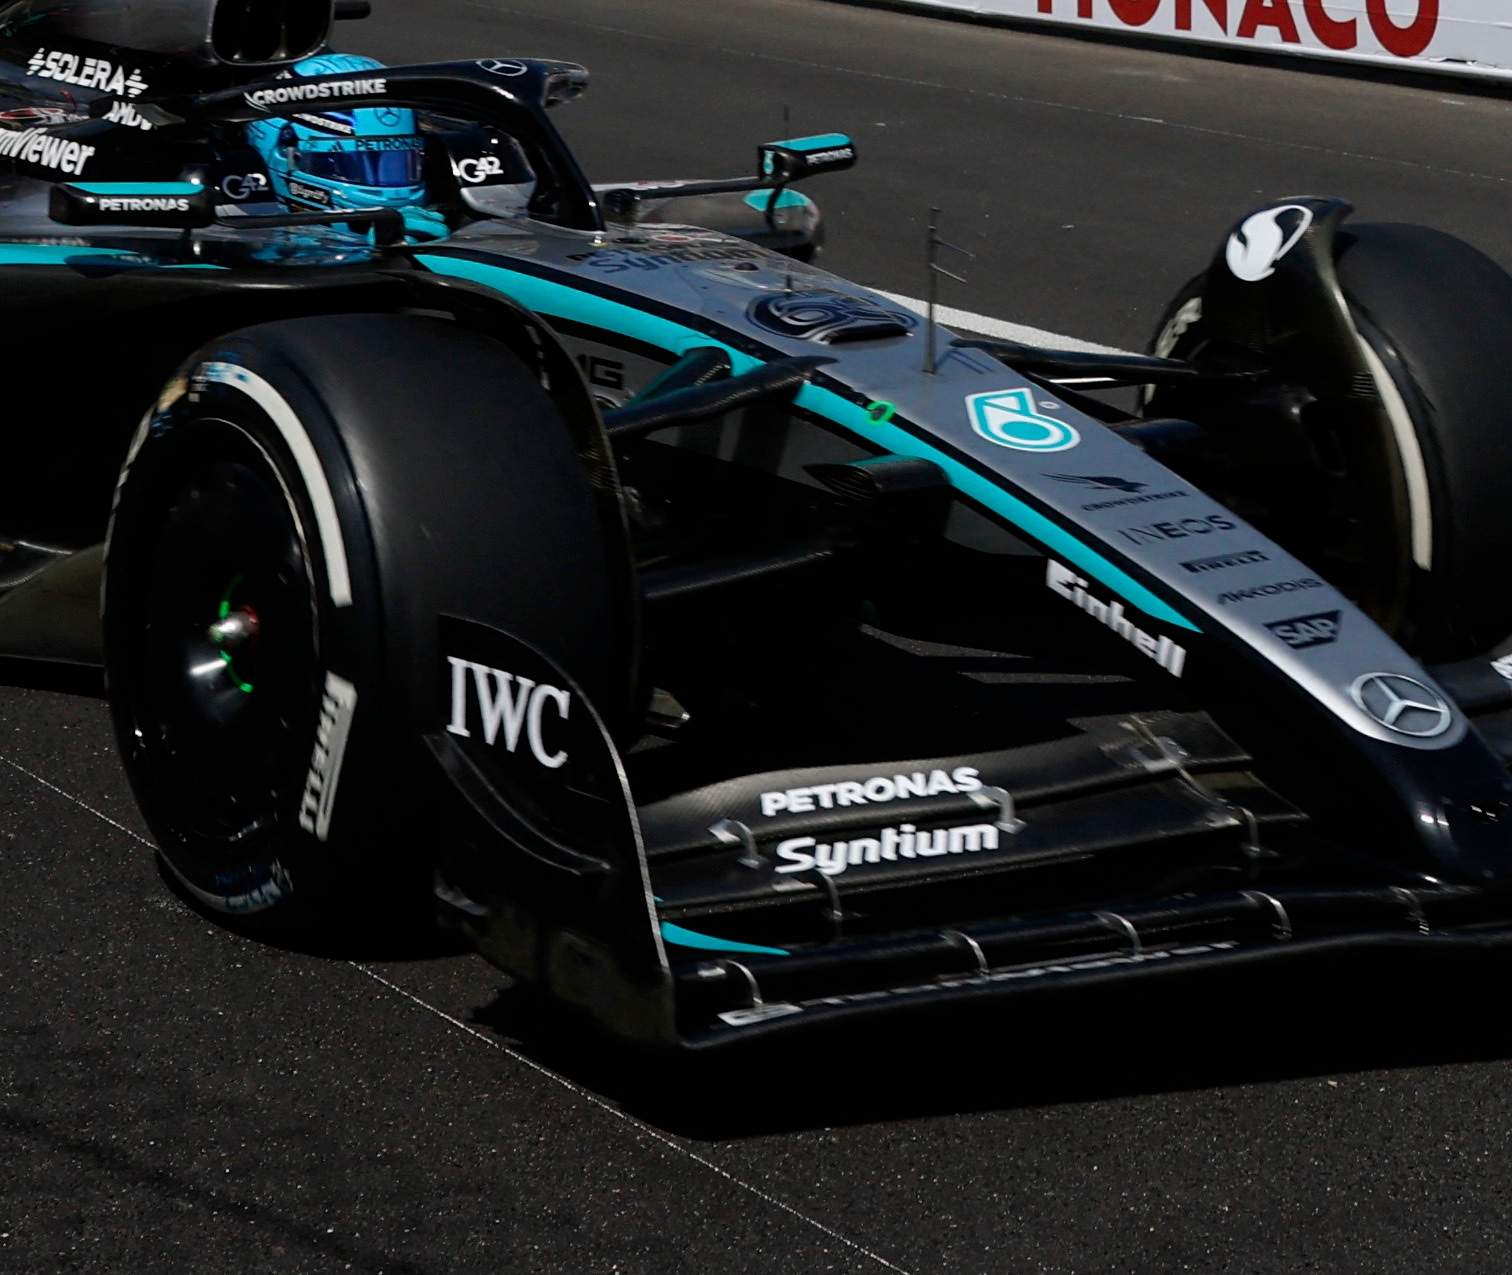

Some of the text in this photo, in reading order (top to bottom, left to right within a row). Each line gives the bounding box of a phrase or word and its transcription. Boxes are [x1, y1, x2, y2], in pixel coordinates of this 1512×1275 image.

[45, 50, 126, 96] SOLERA
[253, 77, 388, 106] CROWDSTRIKE
[99, 197, 189, 213] PETRONAS
[1116, 514, 1238, 546] INEOS
[1046, 558, 1187, 680] Einhell
[1273, 616, 1337, 645] SAP
[446, 655, 571, 769] IWC
[761, 765, 983, 818] PETRONAS
[775, 823, 1000, 877] Syntium
